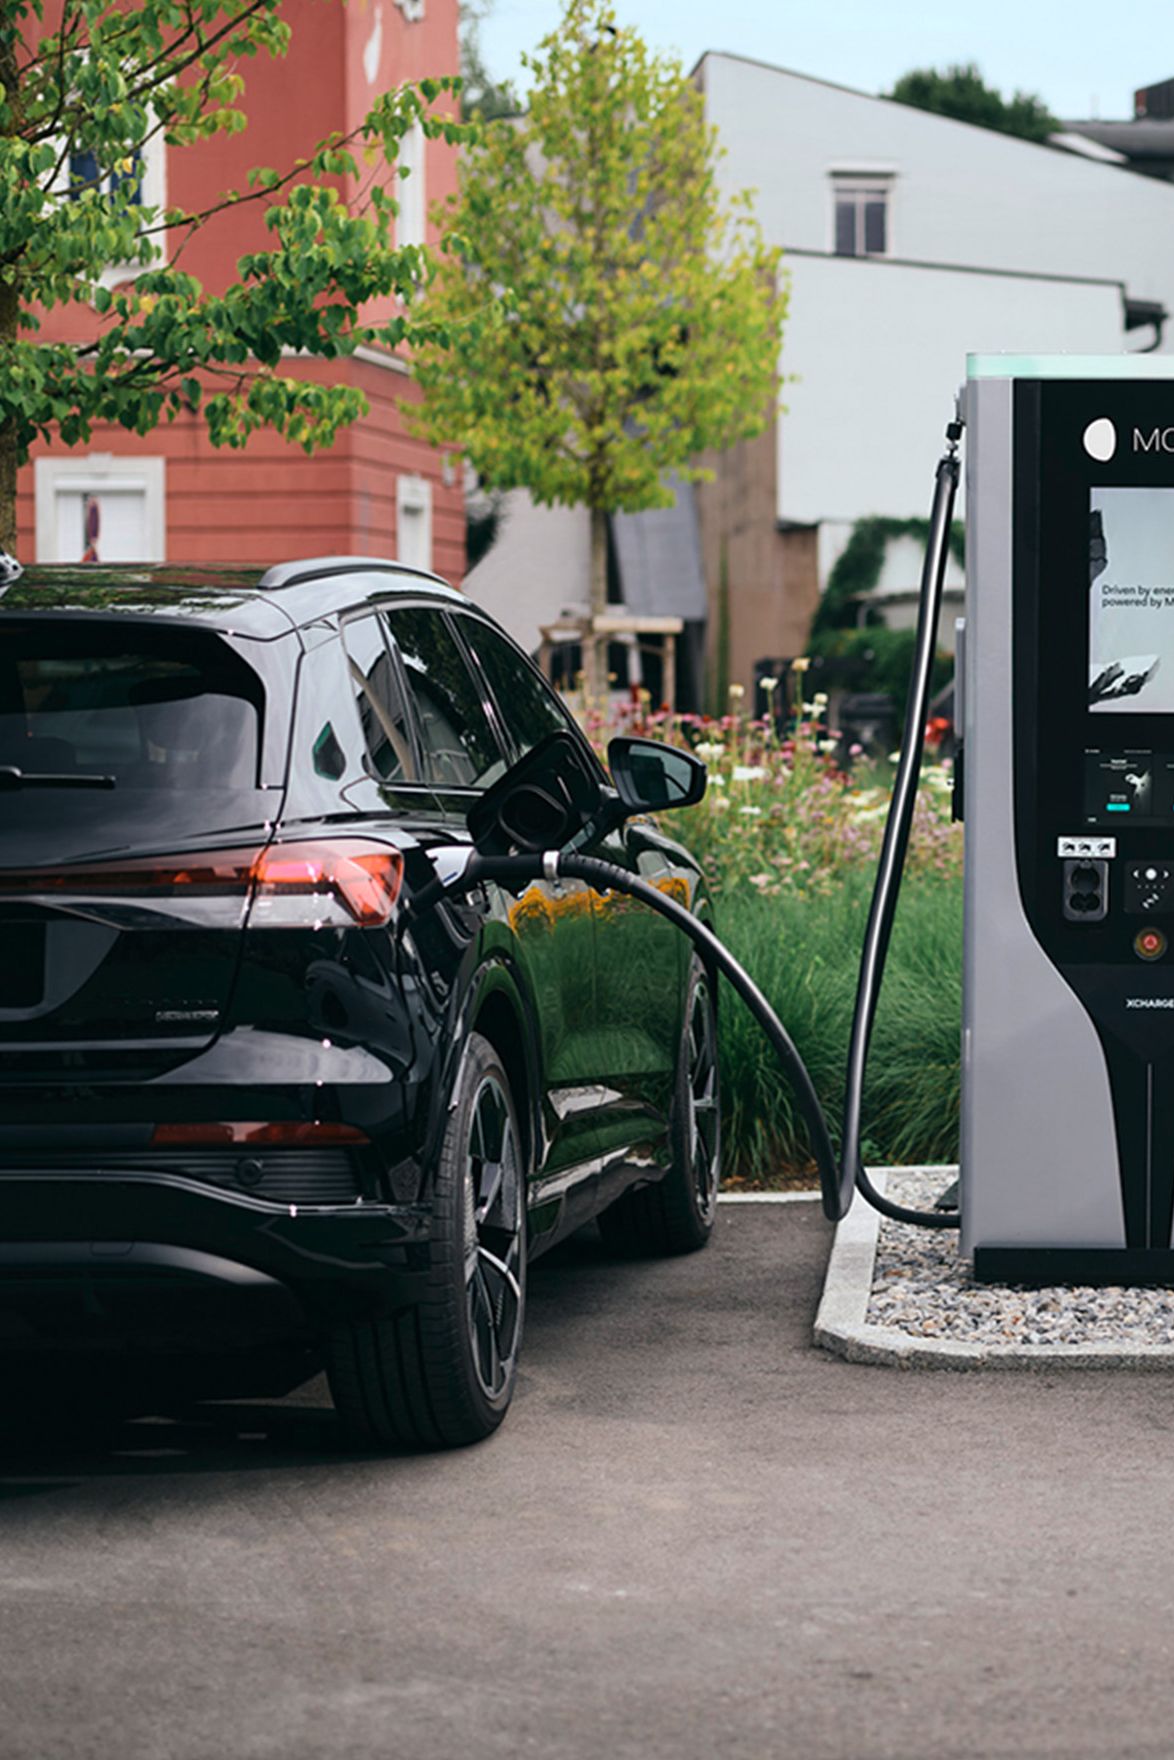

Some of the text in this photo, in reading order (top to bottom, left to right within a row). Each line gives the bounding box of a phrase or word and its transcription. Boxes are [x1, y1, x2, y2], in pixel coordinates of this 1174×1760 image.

[1102, 585, 1136, 595] Driven
[1138, 585, 1150, 599] by
[1102, 597, 1147, 608] powered
[1150, 597, 1162, 609] by
[1126, 998, 1174, 1008] XCHARGE
